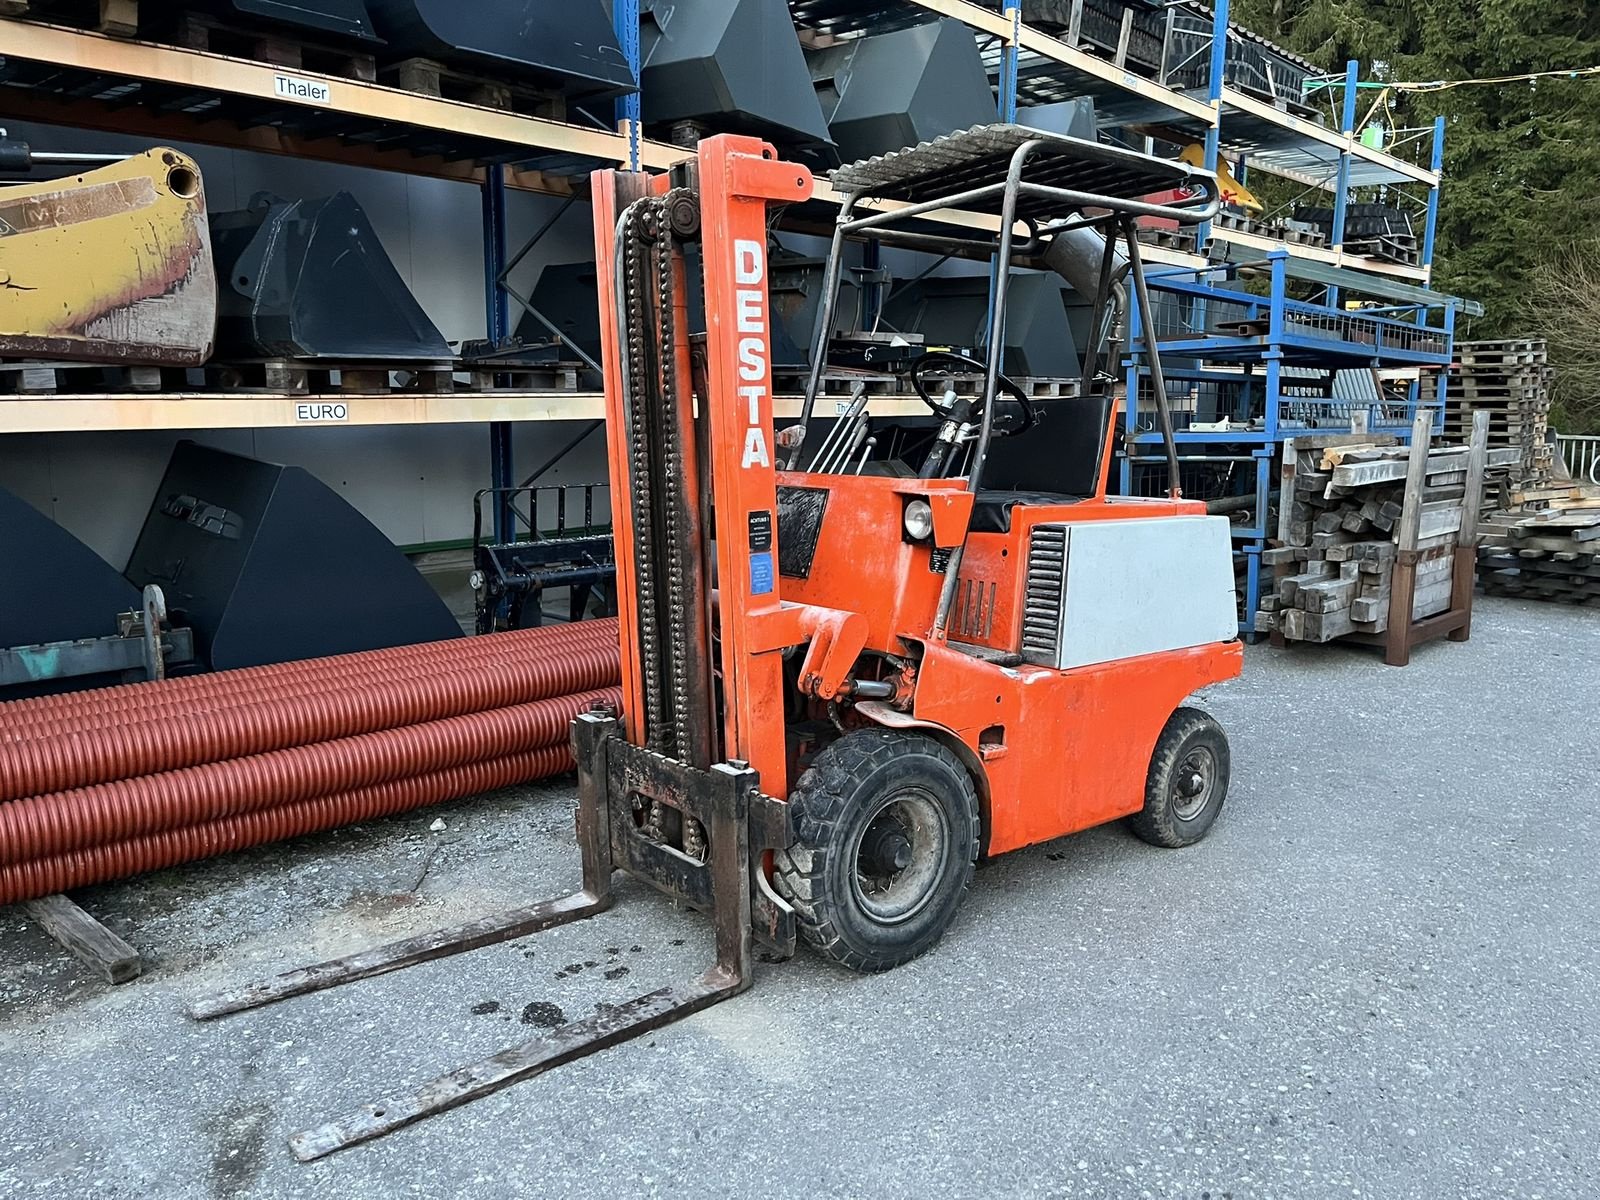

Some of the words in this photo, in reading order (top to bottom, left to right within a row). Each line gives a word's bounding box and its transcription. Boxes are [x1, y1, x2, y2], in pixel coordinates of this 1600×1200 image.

[275, 76, 327, 100] Thaler
[734, 239, 770, 469] DESTA
[297, 404, 346, 419] EURO
